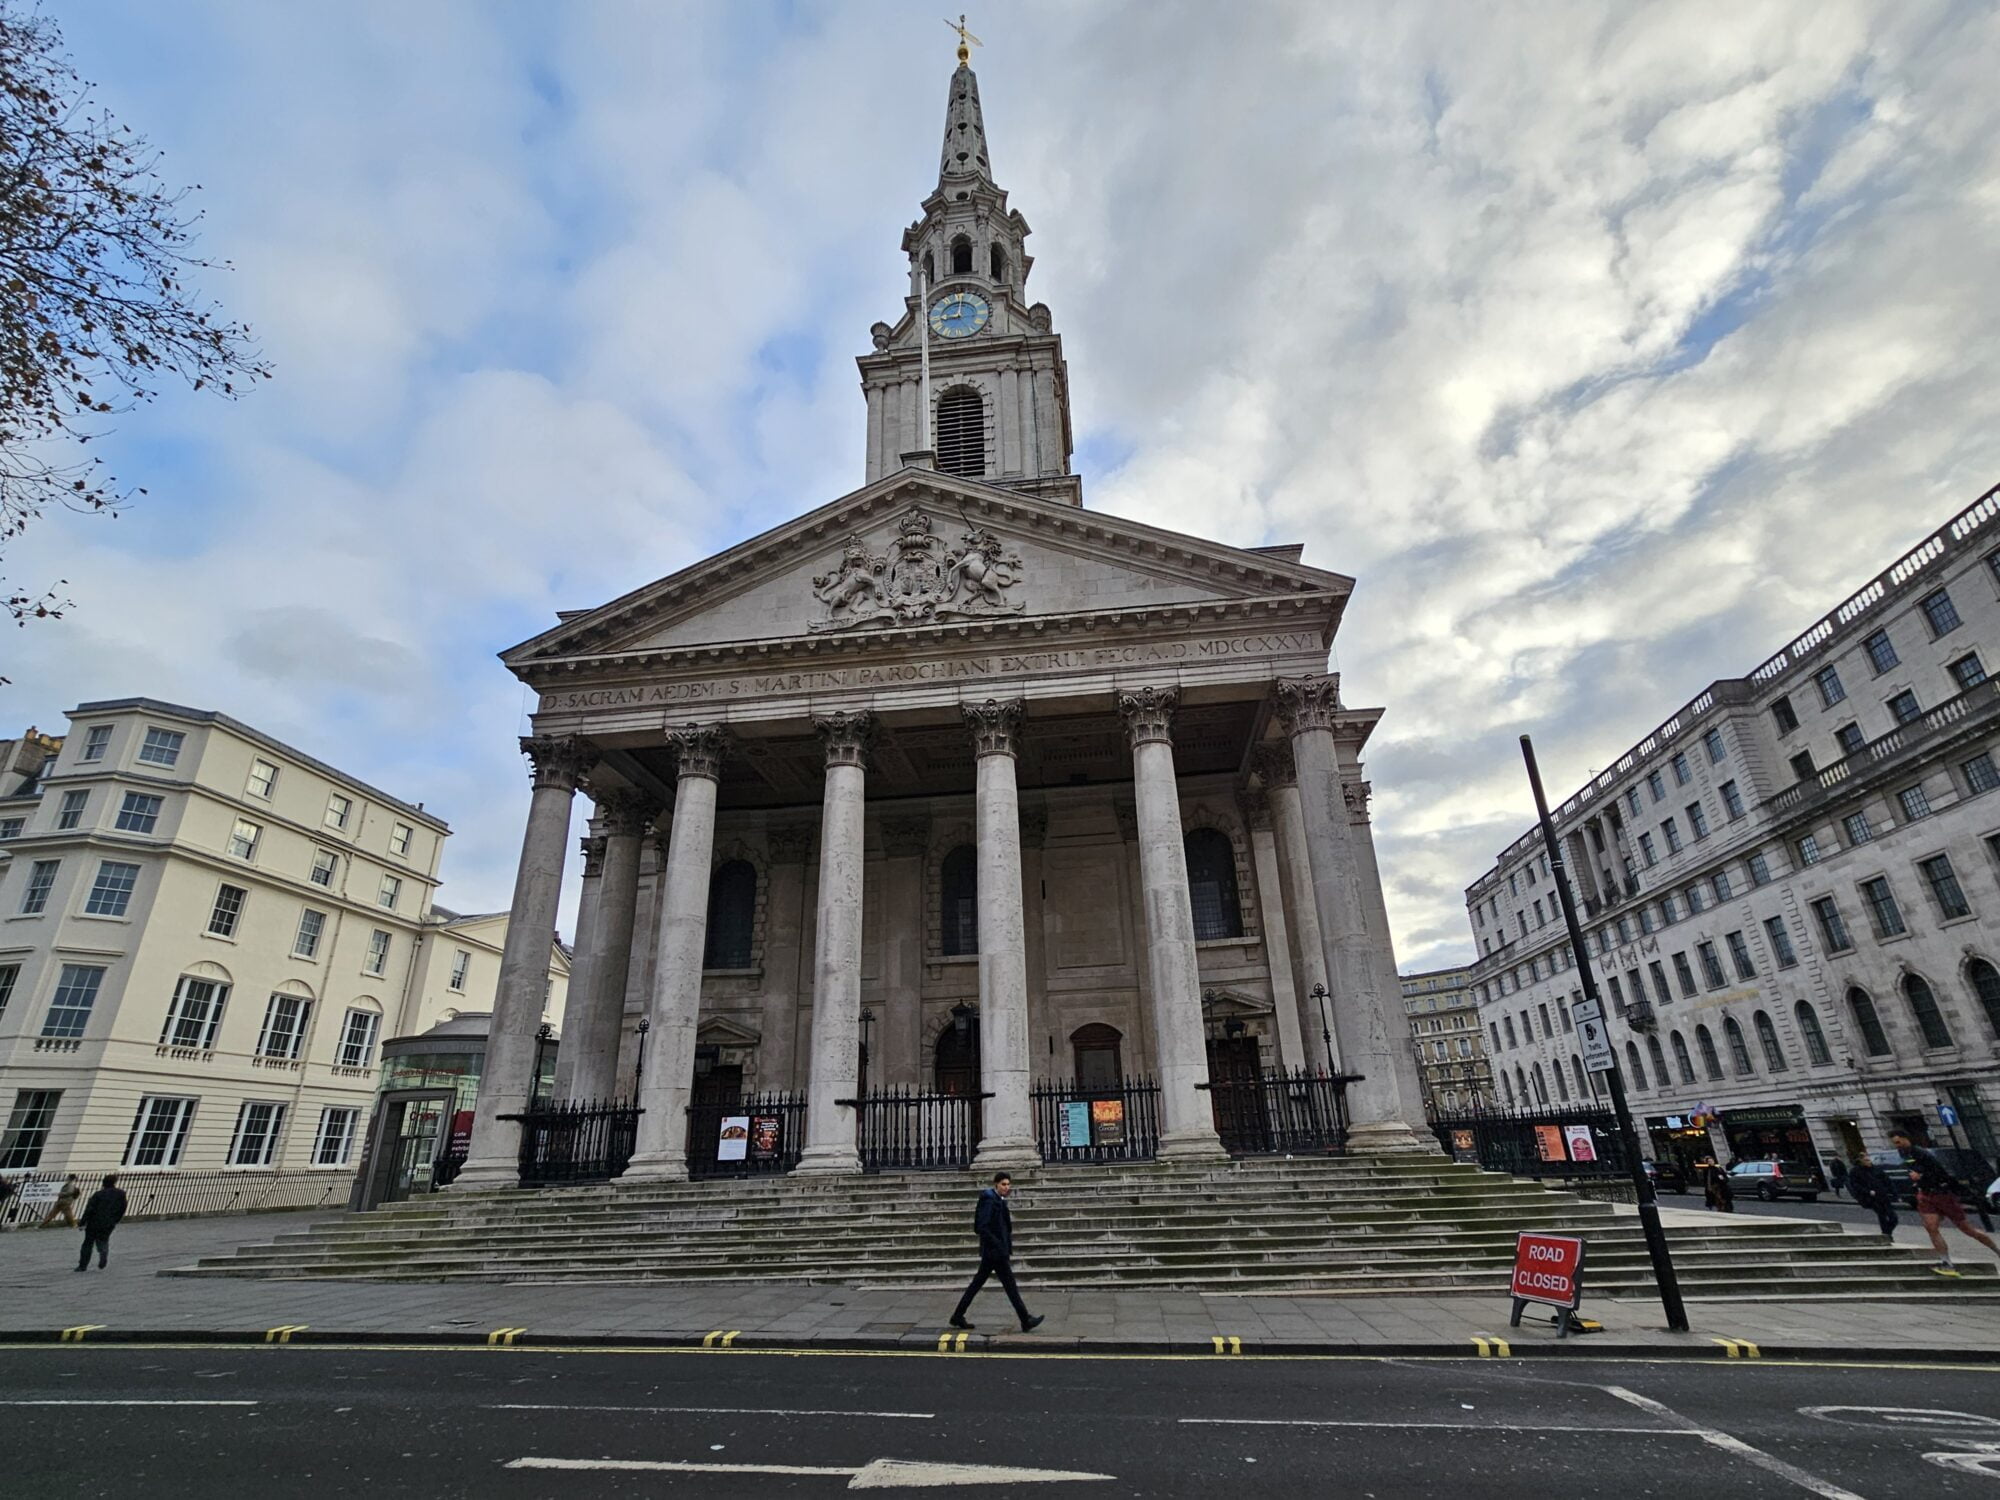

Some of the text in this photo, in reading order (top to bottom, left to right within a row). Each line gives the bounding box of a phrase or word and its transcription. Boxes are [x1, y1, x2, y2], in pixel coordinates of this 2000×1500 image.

[569, 688, 643, 708] SACRAM
[755, 672, 846, 692] MARTINI
[859, 659, 989, 683] PAROCHIANI
[1001, 651, 1086, 672] EXTRUI
[410, 1111, 437, 1123] Crypt
[1528, 1244, 1565, 1263] ROAD
[1518, 1270, 1569, 1292] CLOSED
